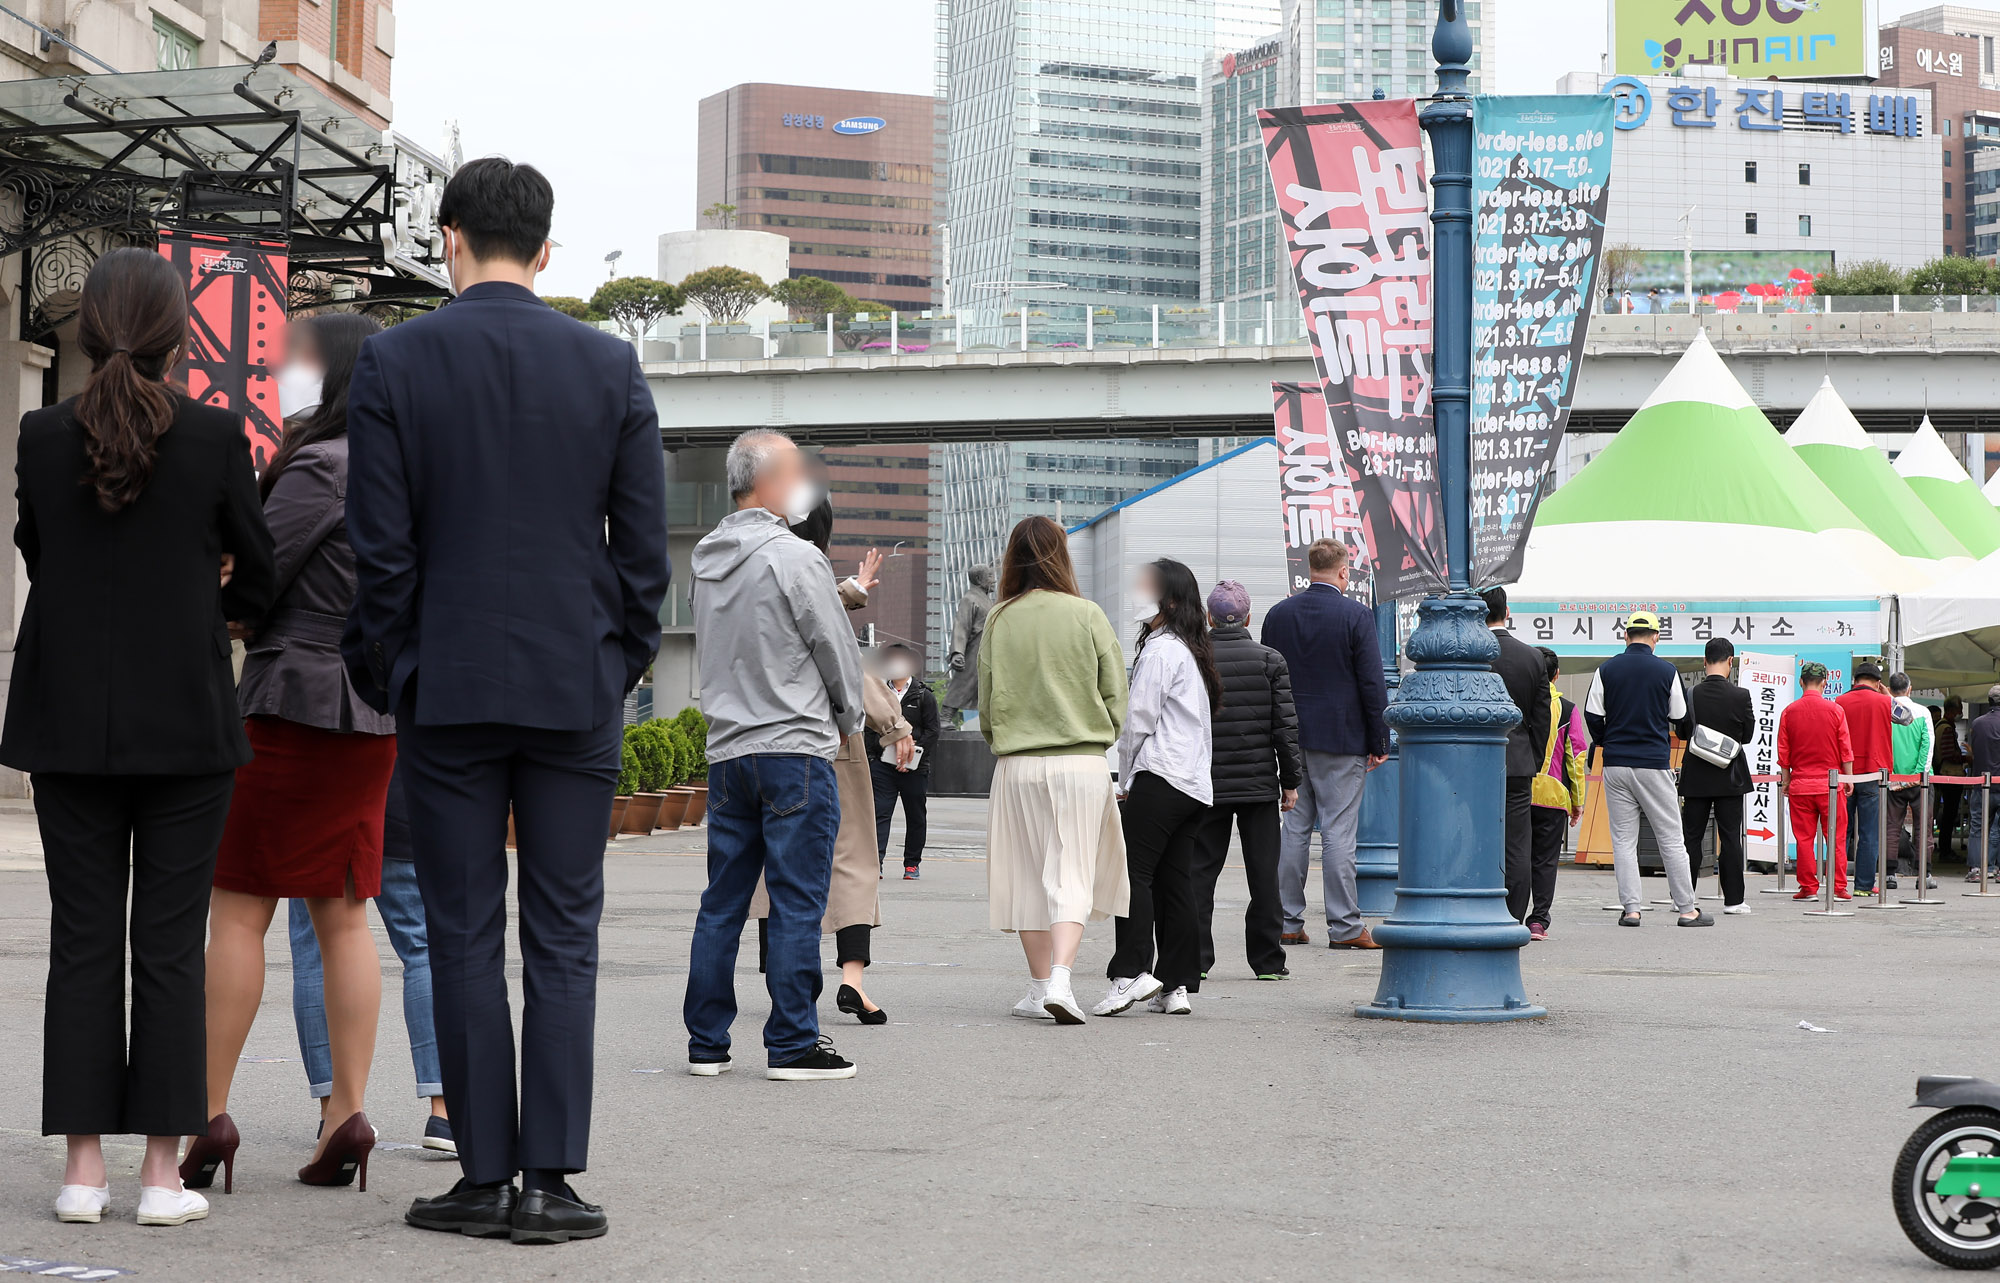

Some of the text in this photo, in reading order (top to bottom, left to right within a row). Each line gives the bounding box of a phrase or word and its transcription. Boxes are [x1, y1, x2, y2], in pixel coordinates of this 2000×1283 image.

[1916, 48, 1963, 77] 에스원
[1667, 86, 1918, 138] 한진택배
[782, 112, 824, 129] 삼성생명
[840, 120, 879, 131] SAMSUNG
[1558, 603, 1658, 613] 코로나바이러스감염증
[1751, 672, 1787, 686] 코로나19
